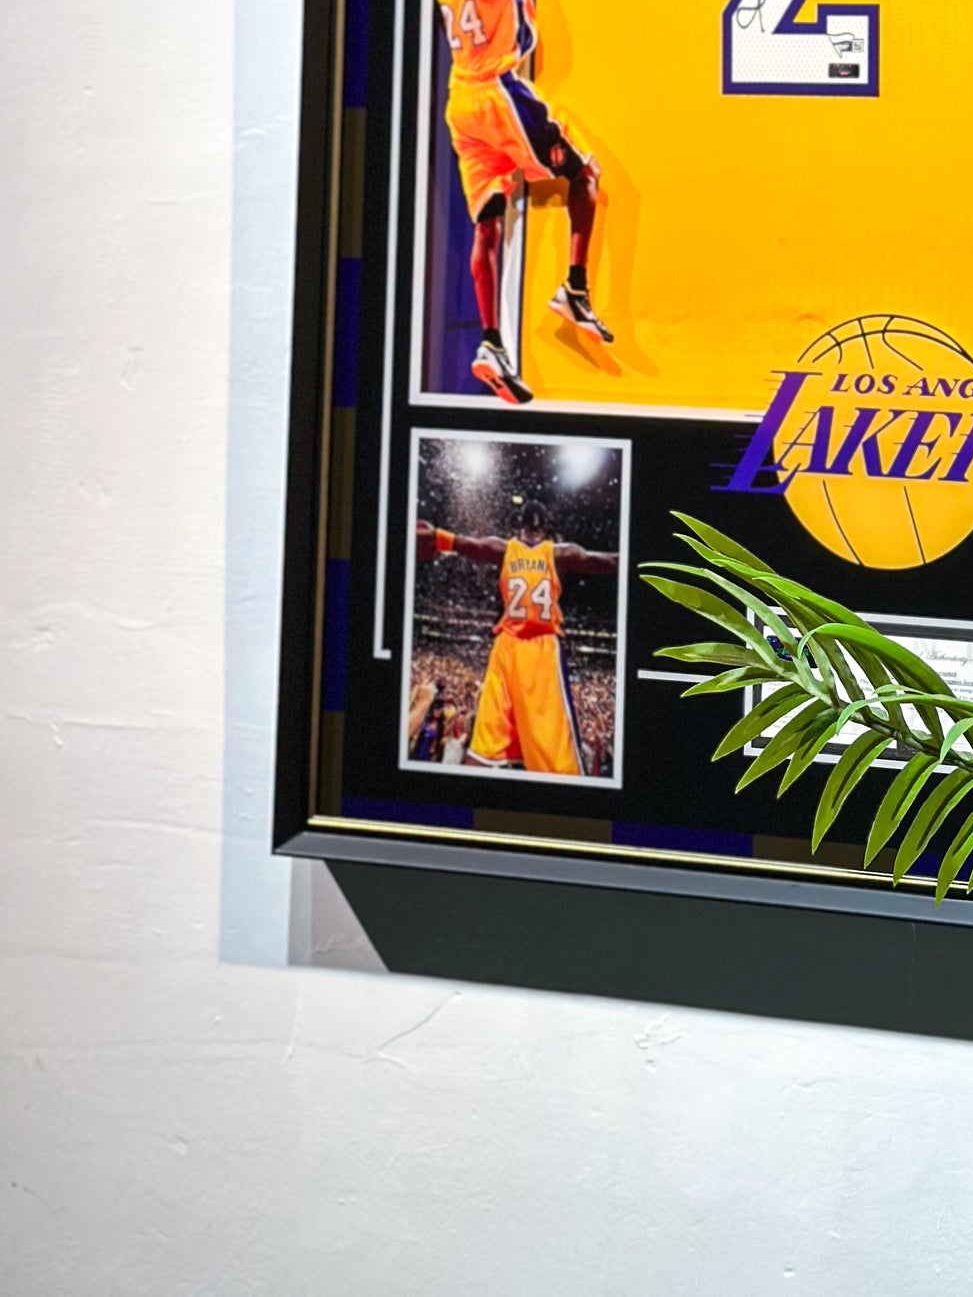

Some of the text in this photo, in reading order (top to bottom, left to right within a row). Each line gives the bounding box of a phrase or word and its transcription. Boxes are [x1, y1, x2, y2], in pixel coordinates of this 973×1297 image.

[830, 373, 897, 395] LOS
[509, 558, 548, 574] BRYAN
[507, 577, 552, 622] 24
